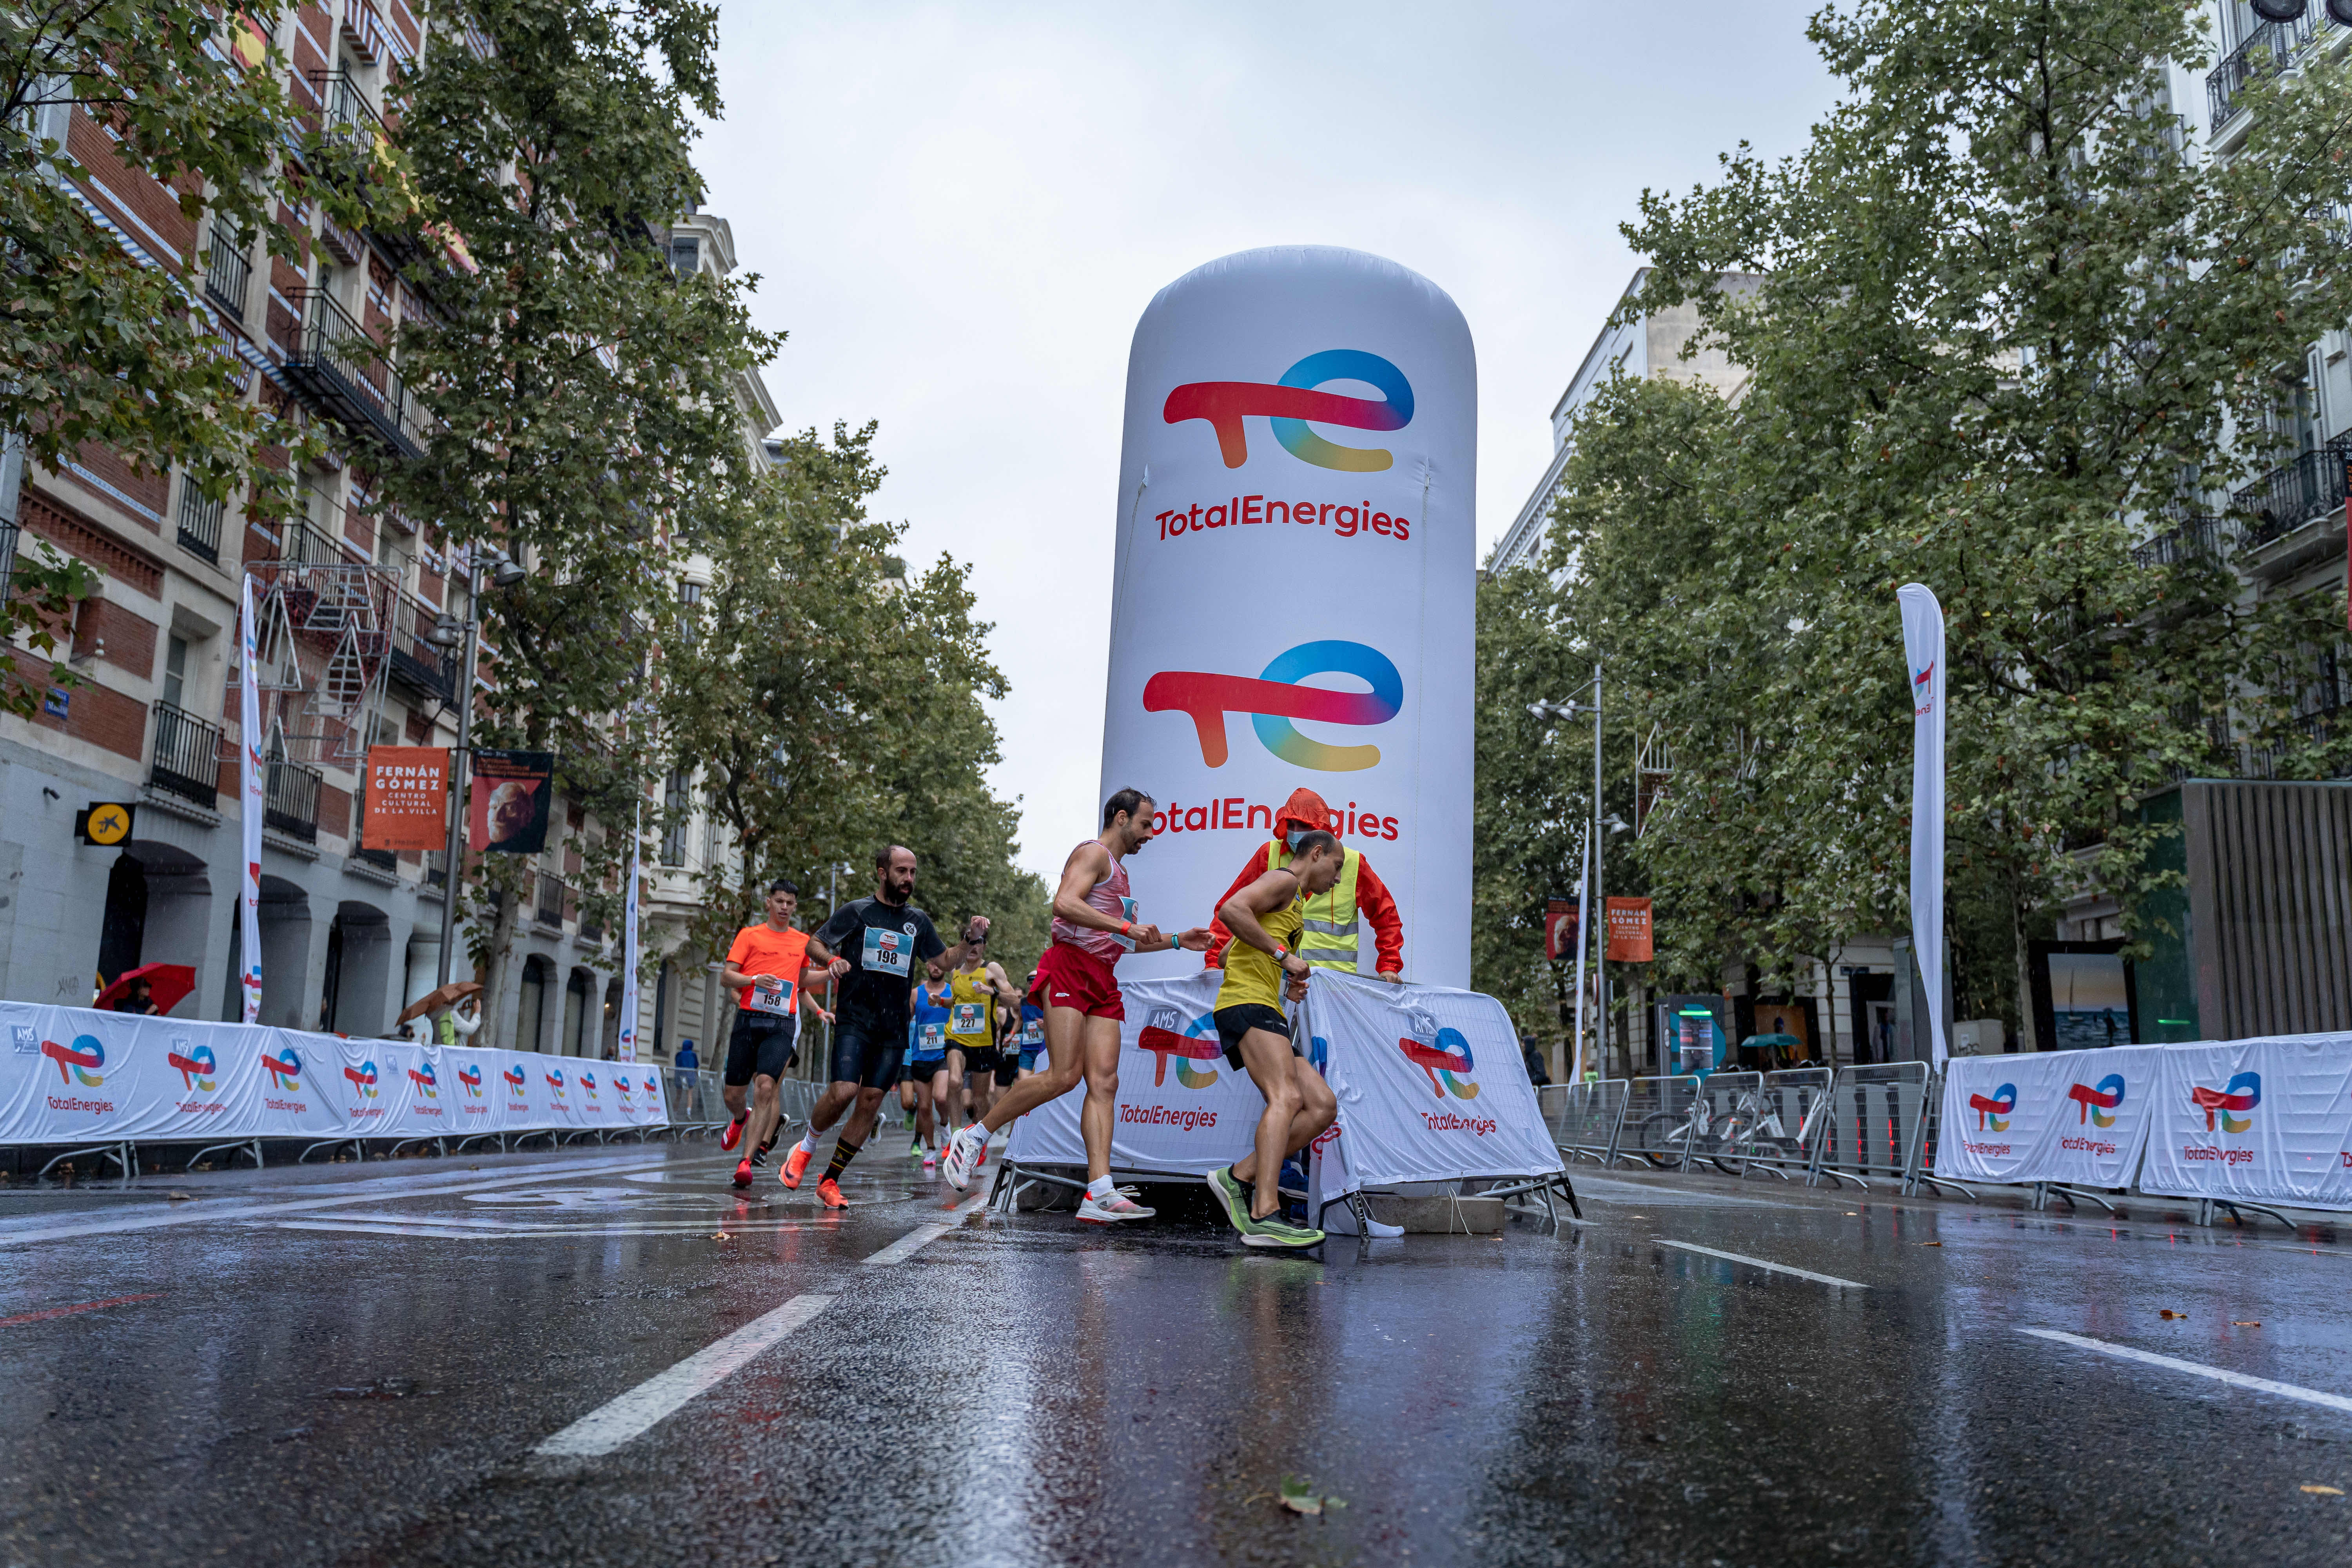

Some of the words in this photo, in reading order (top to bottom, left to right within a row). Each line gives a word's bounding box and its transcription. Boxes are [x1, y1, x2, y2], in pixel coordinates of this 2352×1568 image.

[1155, 495, 1410, 541] TotalEnergies
[376, 764, 439, 777] FERNÁN
[376, 776, 439, 790] GÓMEZ
[877, 950, 898, 965] 198
[764, 994, 781, 1006] 158
[961, 1019, 975, 1028] 227
[1152, 1011, 1178, 1029] AMS
[17, 1027, 34, 1041] AMS
[1028, 1031, 1039, 1040] 204
[48, 1096, 113, 1114] TotalEnergies
[265, 1098, 307, 1114] TotalEnergies
[1120, 1104, 1217, 1131] TotalEnergies
